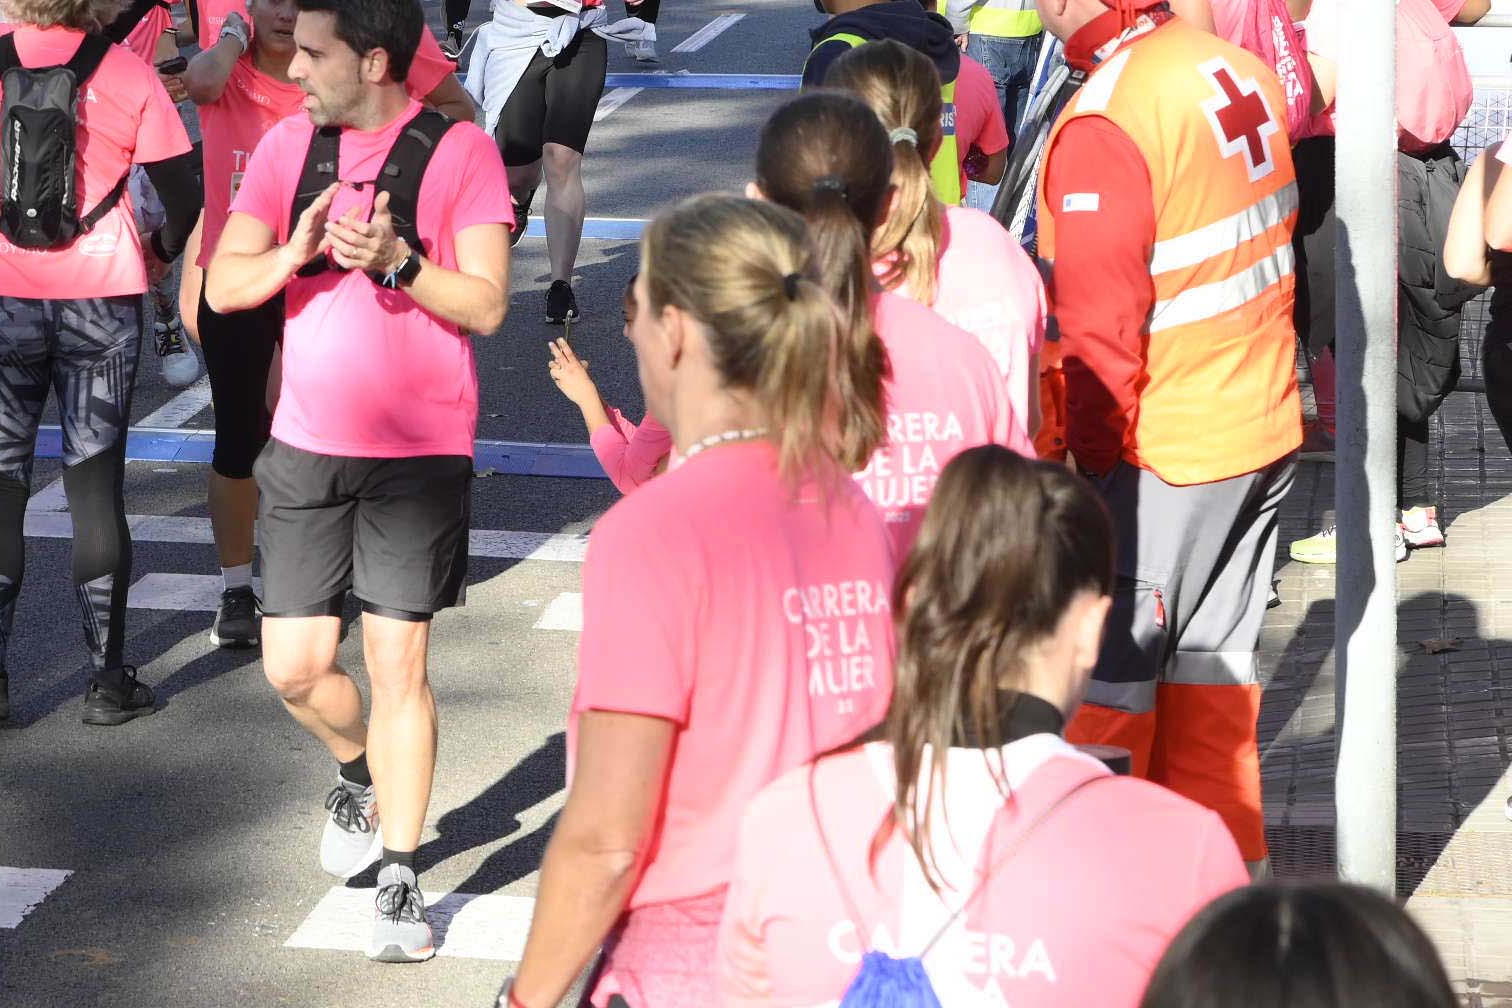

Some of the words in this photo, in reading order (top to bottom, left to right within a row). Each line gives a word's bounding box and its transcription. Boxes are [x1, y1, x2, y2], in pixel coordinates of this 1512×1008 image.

[887, 411, 965, 443] RERA
[863, 447, 893, 478] E
[902, 444, 939, 475] LA
[861, 475, 939, 508] UJE
[782, 579, 890, 624] CARRERA
[839, 619, 873, 654] LA
[807, 655, 876, 697] UJER
[827, 917, 1058, 984] CAERA
